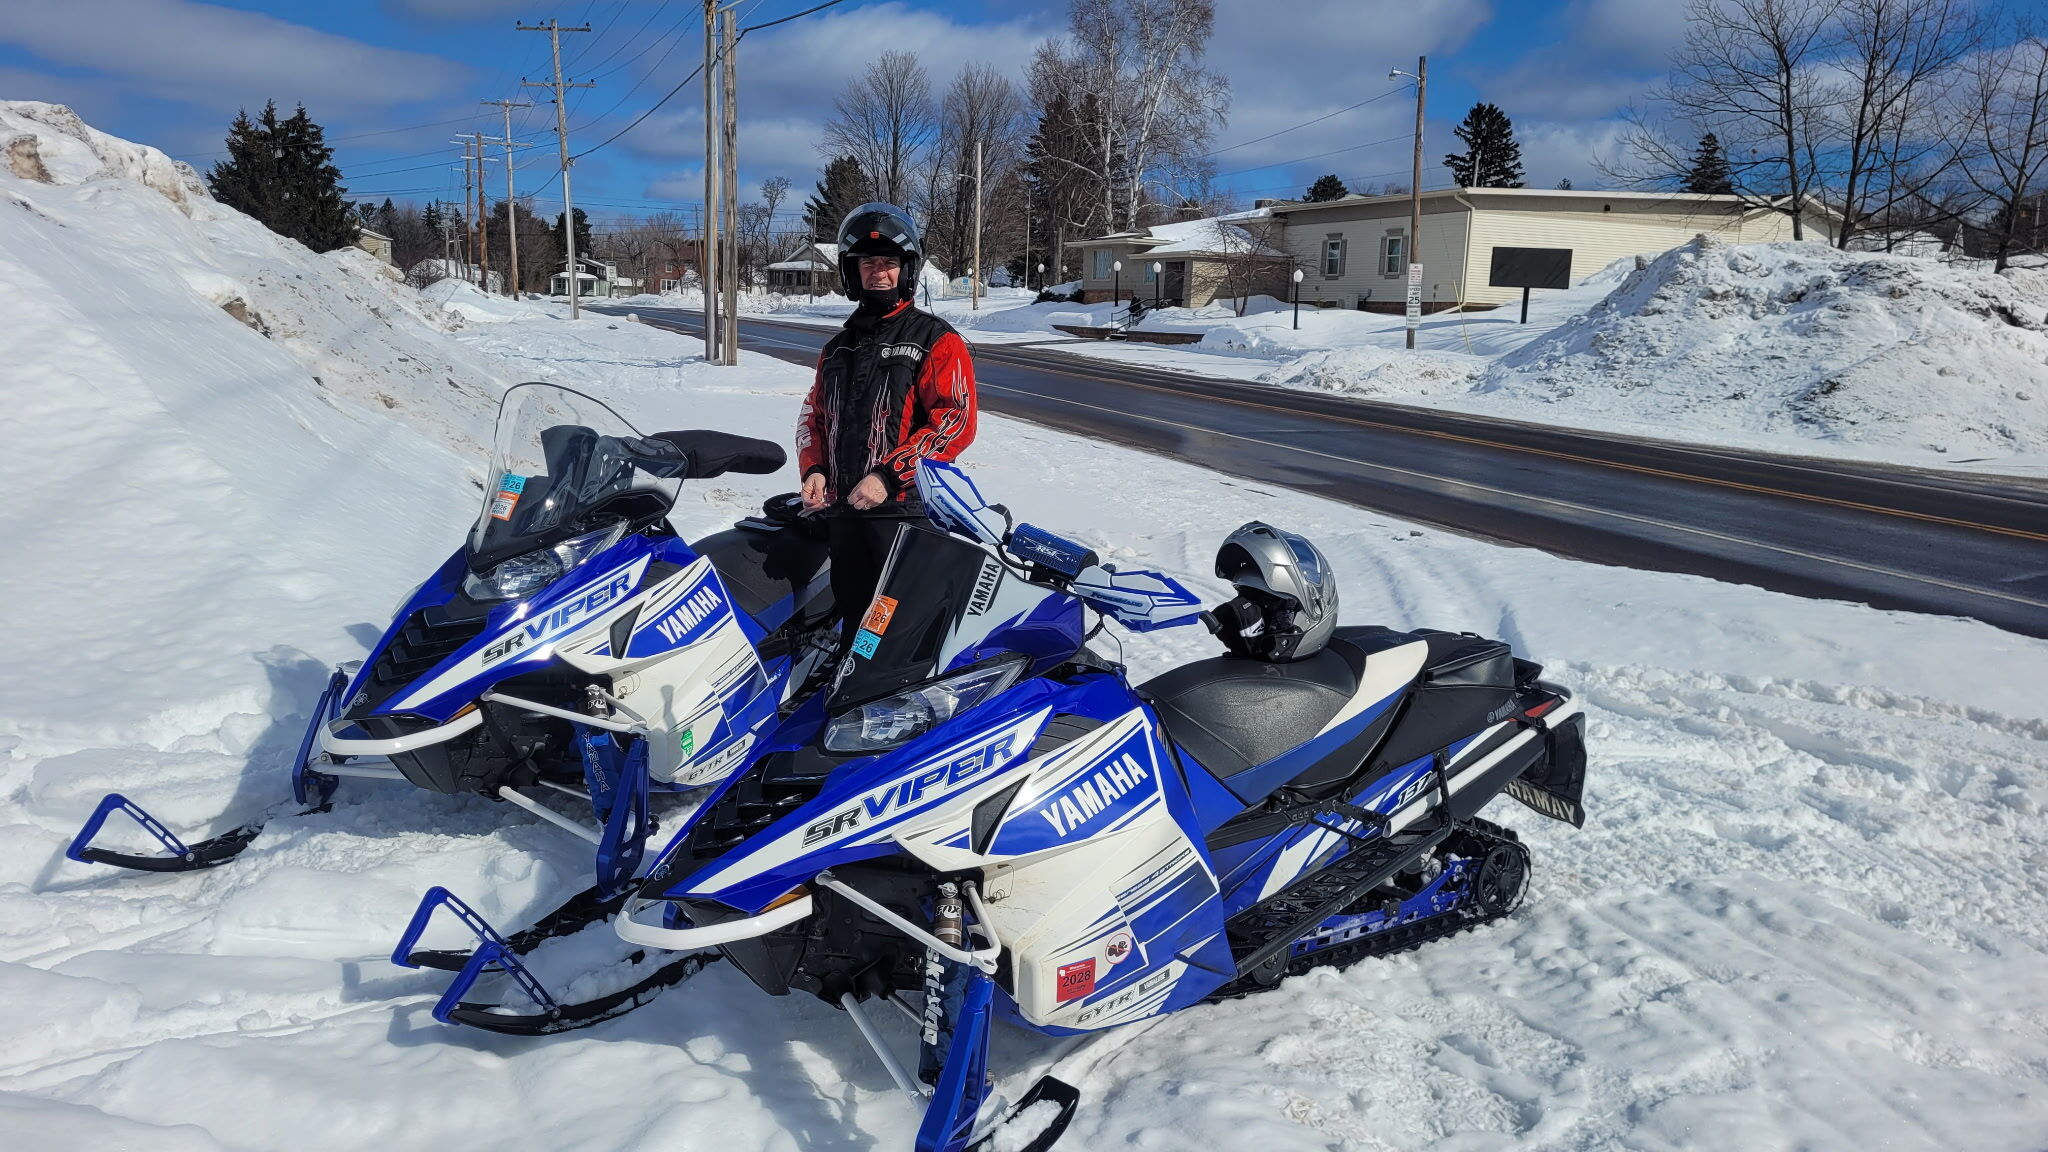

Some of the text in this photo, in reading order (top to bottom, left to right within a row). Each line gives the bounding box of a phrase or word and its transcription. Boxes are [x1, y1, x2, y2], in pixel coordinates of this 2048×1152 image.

[1408, 296, 1420, 304] 25
[891, 346, 922, 361] YAMAHA
[509, 480, 521, 490] 26
[968, 563, 999, 617] YAMAHA
[482, 571, 631, 667] SR VIPER
[656, 585, 722, 645] YAMAHA
[871, 610, 887, 624] 026
[860, 640, 874, 653] 26
[583, 731, 611, 793] YAMAHA
[802, 729, 1019, 849] SR VIPER
[1039, 752, 1149, 838] YAMAHA
[1399, 770, 1433, 807] 137
[936, 904, 962, 919] FOX
[1062, 970, 1091, 987] 2028
[1075, 988, 1135, 1026] GYTR
